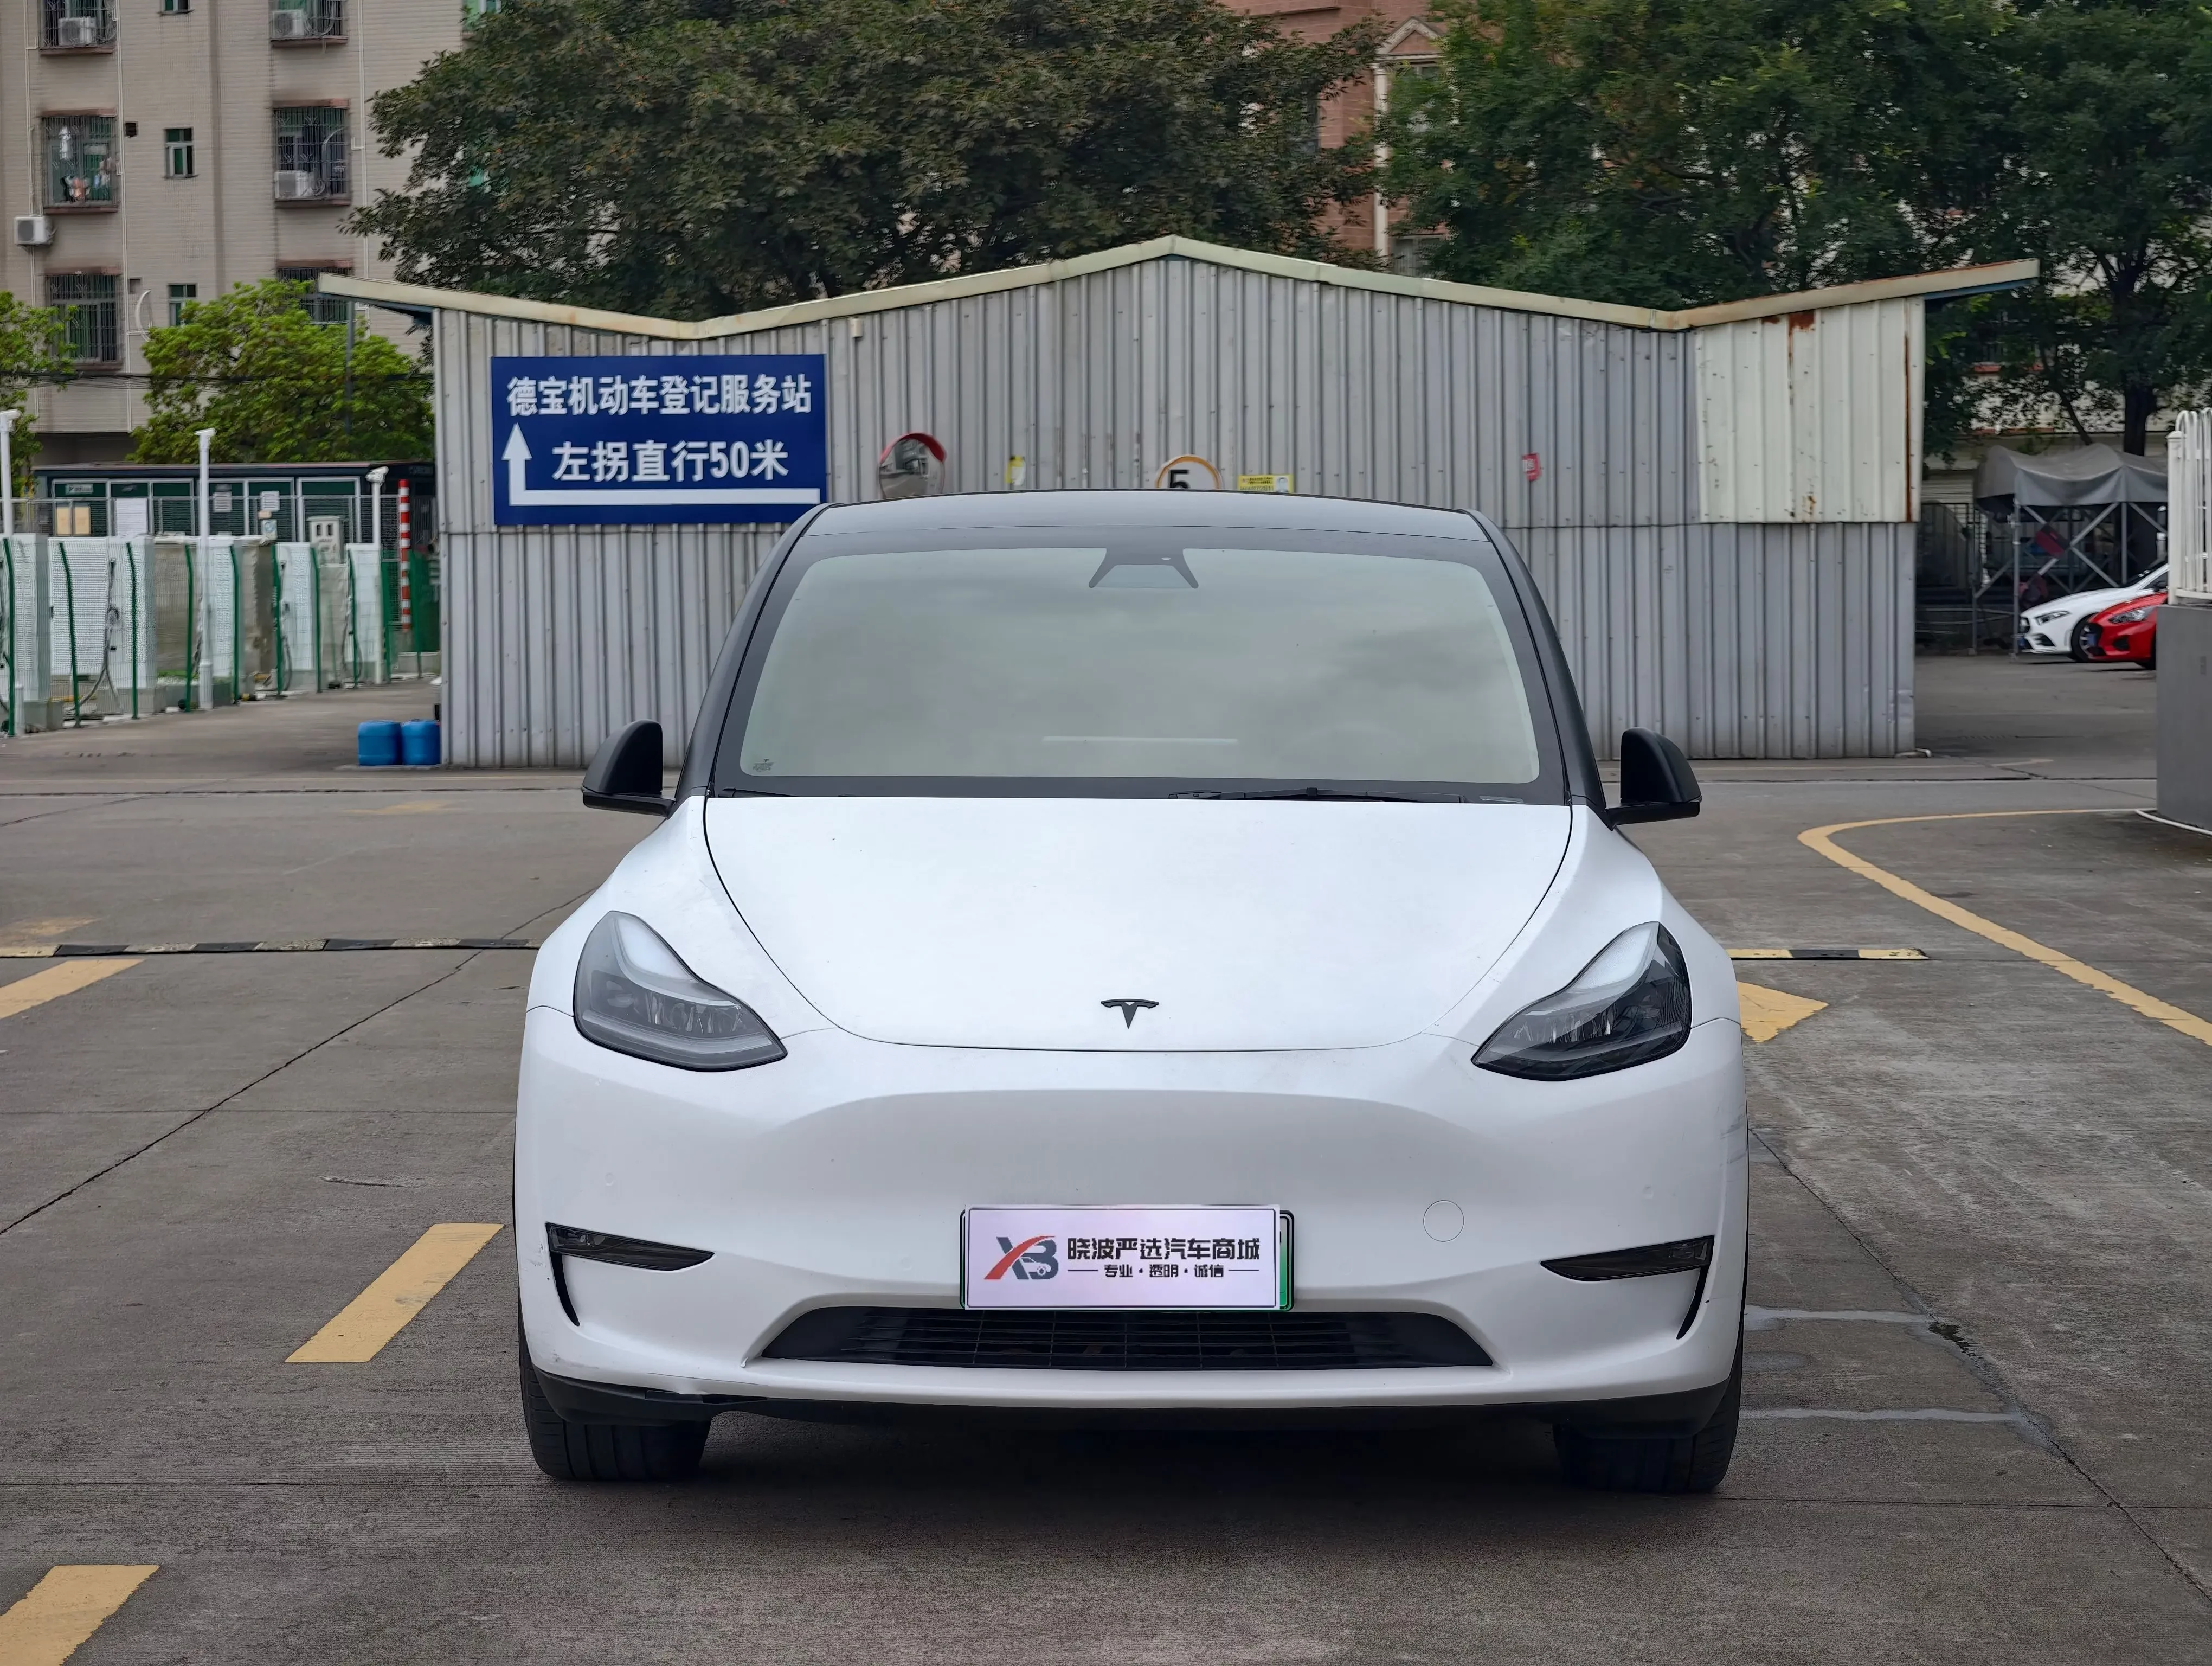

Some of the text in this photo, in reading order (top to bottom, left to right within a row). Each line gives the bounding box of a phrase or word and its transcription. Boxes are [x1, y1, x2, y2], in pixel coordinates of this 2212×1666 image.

[506, 374, 812, 416] 德宝机动车登记服务站
[551, 439, 789, 482] 左拐直行50米
